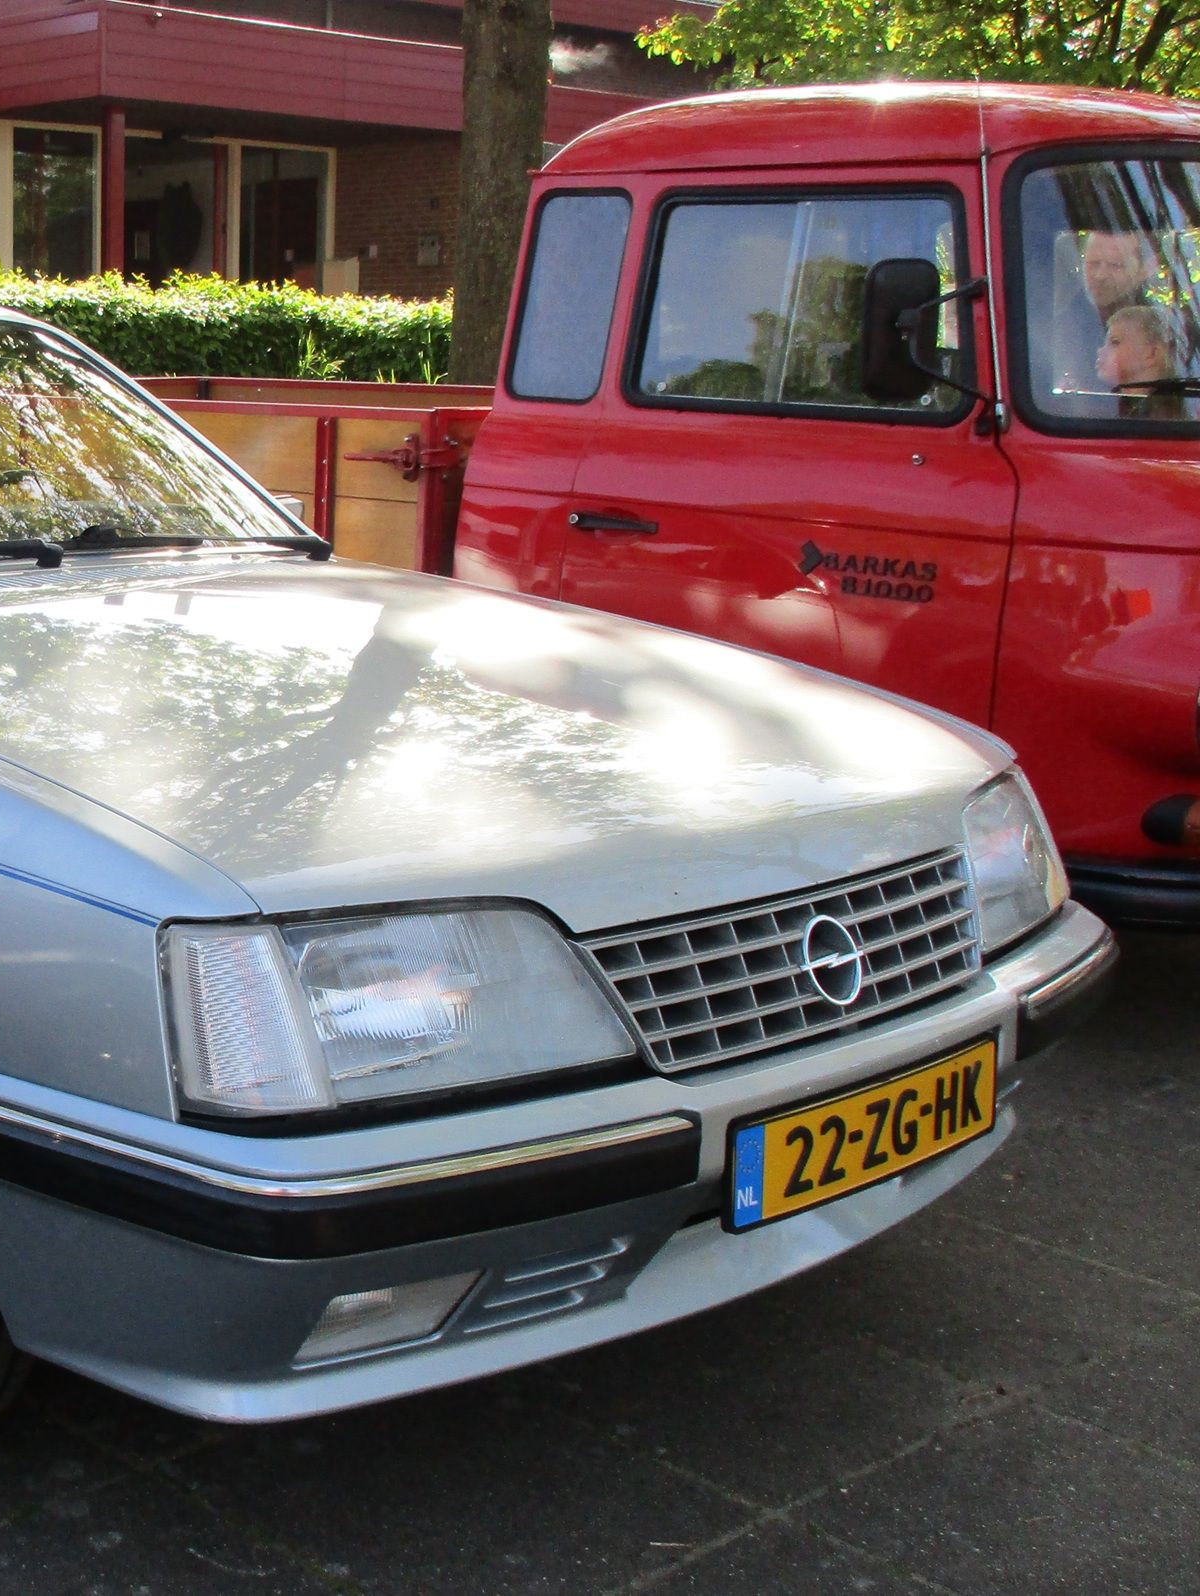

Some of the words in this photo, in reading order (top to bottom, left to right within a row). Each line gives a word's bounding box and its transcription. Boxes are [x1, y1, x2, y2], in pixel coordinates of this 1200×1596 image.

[823, 552, 938, 582] BARKAS
[784, 1060, 982, 1198] 22-ZG-HK
[737, 1186, 758, 1210] NL
